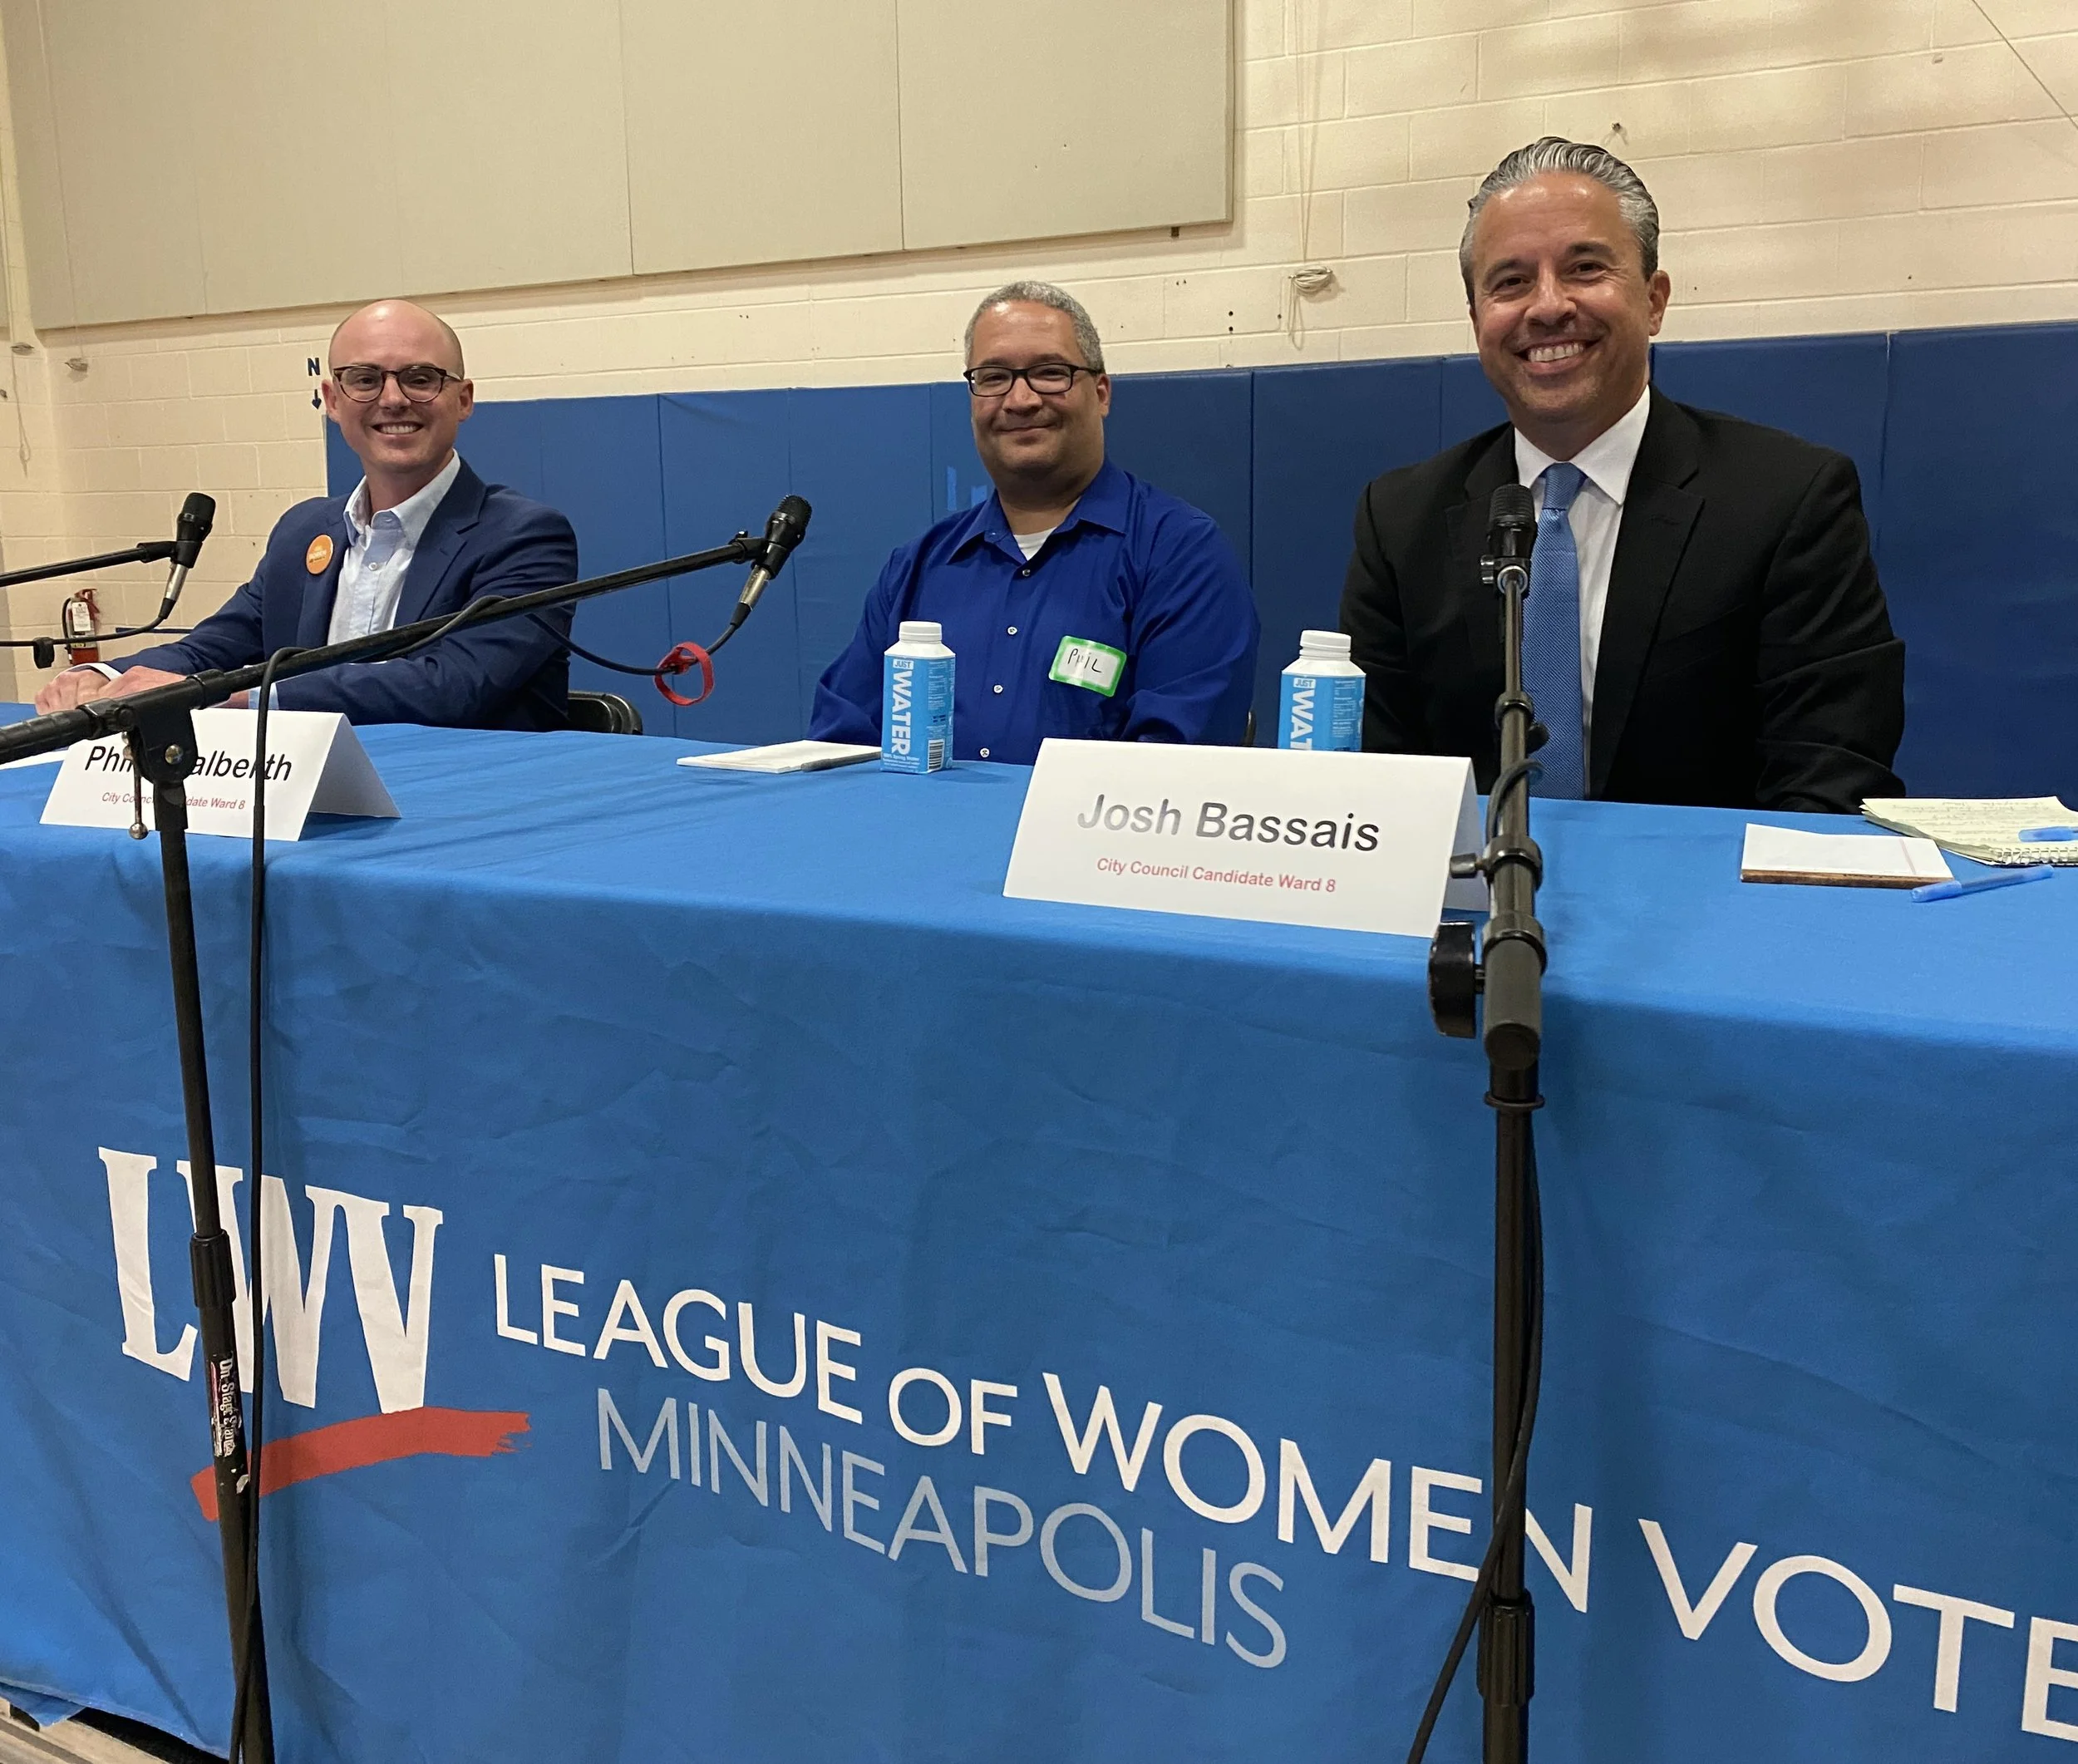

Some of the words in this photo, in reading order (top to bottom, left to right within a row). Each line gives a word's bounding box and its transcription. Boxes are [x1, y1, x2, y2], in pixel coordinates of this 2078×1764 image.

[307, 357, 321, 377] N
[1295, 678, 1314, 687] JUST
[891, 670, 913, 756] WATER
[1290, 689, 1315, 751] WAT
[101, 791, 121, 805] City
[210, 797, 238, 810] Ward
[238, 800, 246, 810] 8
[1076, 793, 1183, 836] Josh
[1195, 801, 1380, 852] Bassais
[1096, 857, 1127, 876] City
[1130, 860, 1189, 880] Council
[1192, 866, 1274, 887] Candidate
[1278, 874, 1322, 892] Ward
[1325, 878, 1337, 893] 8
[97, 1146, 443, 1415] LWV
[494, 1253, 864, 1426] LEAGUE
[887, 1367, 1018, 1456] OF
[1041, 1372, 1593, 1614] WOMEN
[1637, 1518, 2078, 1743] VOTE
[597, 1387, 1288, 1669] MINNEAPOLIS
